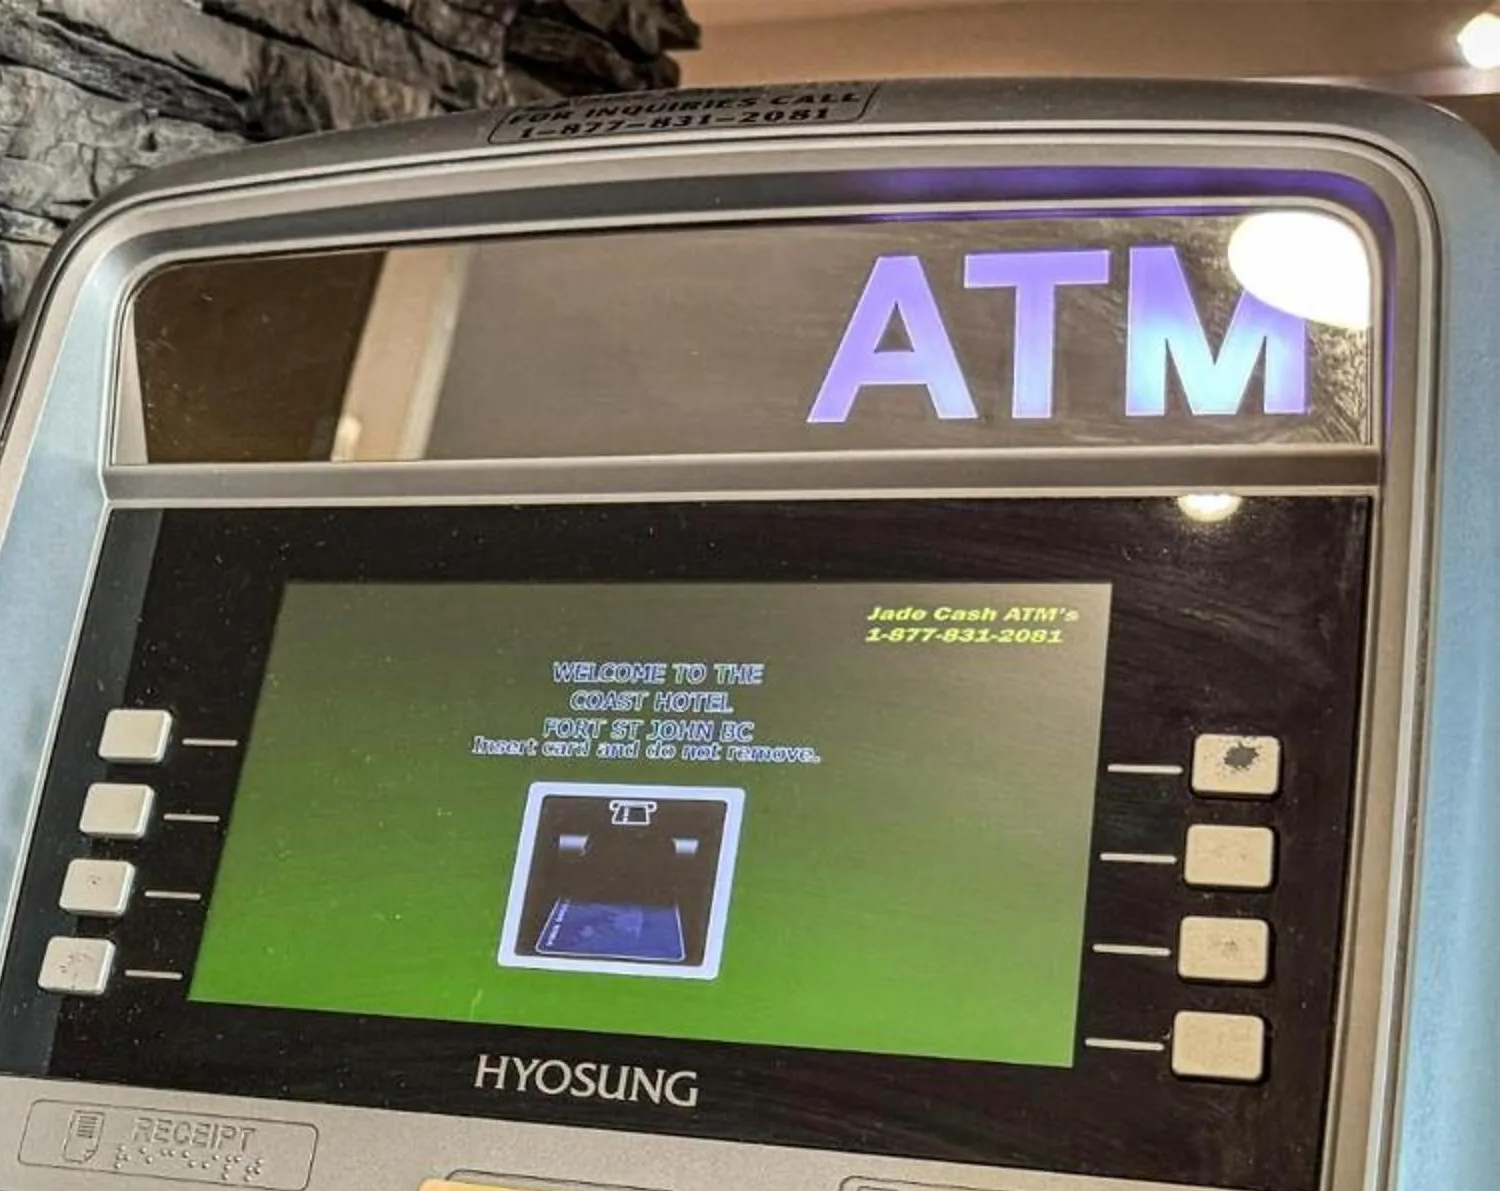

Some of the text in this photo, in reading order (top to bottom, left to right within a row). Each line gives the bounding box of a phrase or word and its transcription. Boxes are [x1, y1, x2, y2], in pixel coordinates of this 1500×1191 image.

[585, 97, 759, 119] INQUIRIES
[769, 92, 861, 105] CALL
[520, 107, 829, 139] 1-877-831-2081
[807, 246, 1308, 423] ATM
[933, 606, 998, 622] Cash
[1003, 606, 1080, 623] ATM's
[865, 627, 1065, 643] 1-877-831-2081
[553, 661, 765, 685] WELCOME TO THE
[569, 689, 735, 713] COAST HOTEL
[543, 717, 756, 742] FORT ST JOHN BC
[472, 735, 539, 756] Insert
[541, 738, 592, 757] card
[596, 739, 641, 759] and
[645, 740, 677, 760] do
[681, 742, 723, 761] not
[473, 1053, 699, 1109] HYOSUNG
[131, 1116, 258, 1152] RECEIPT
